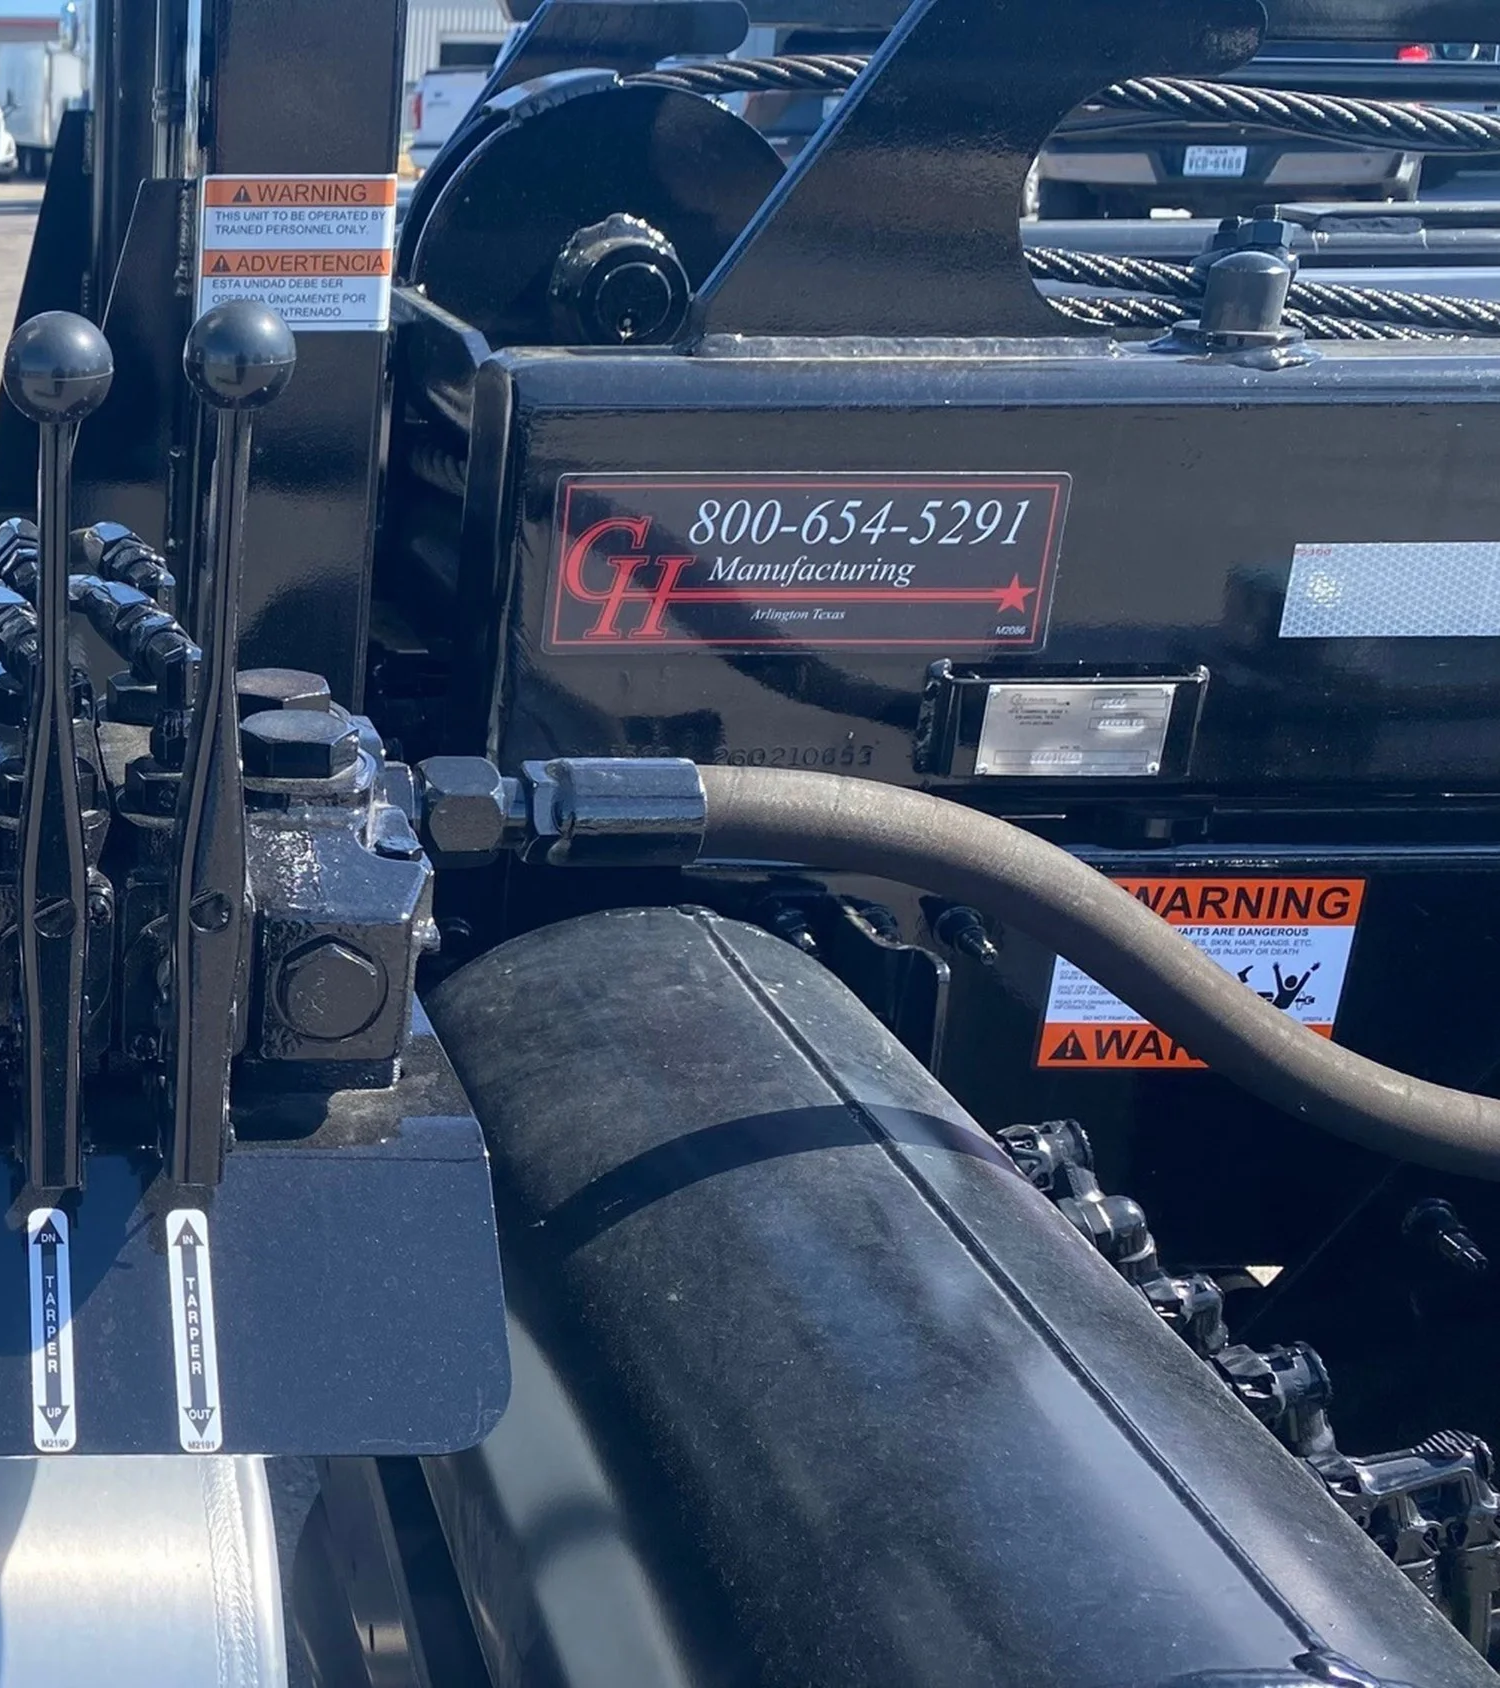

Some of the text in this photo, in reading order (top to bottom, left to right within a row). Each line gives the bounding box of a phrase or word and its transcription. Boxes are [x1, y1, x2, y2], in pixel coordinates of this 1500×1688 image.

[257, 184, 367, 202] WARNING
[216, 211, 386, 221] THIS UNIT TO BE OPERATED BY
[216, 225, 369, 235] TRAINED PERSONNEL ONLY.
[236, 255, 385, 271] ADVERTENCIA
[213, 279, 343, 288] ESTA UNIDAD DEBE SER
[268, 293, 339, 304] ÚNICAMENTE
[343, 295, 366, 303] POR
[689, 499, 1030, 545] 800-654-5291
[708, 556, 915, 587] Manufacturing
[750, 608, 845, 622] Arlington Texas
[1212, 928, 1236, 936] ARE
[1238, 928, 1309, 936] DANGEROUS
[41, 1233, 56, 1243] DN
[182, 1235, 194, 1245] IN
[45, 1276, 58, 1373] TARPER
[186, 1277, 201, 1375] TARPER
[46, 1407, 61, 1417] UP
[188, 1409, 211, 1420] OUT
